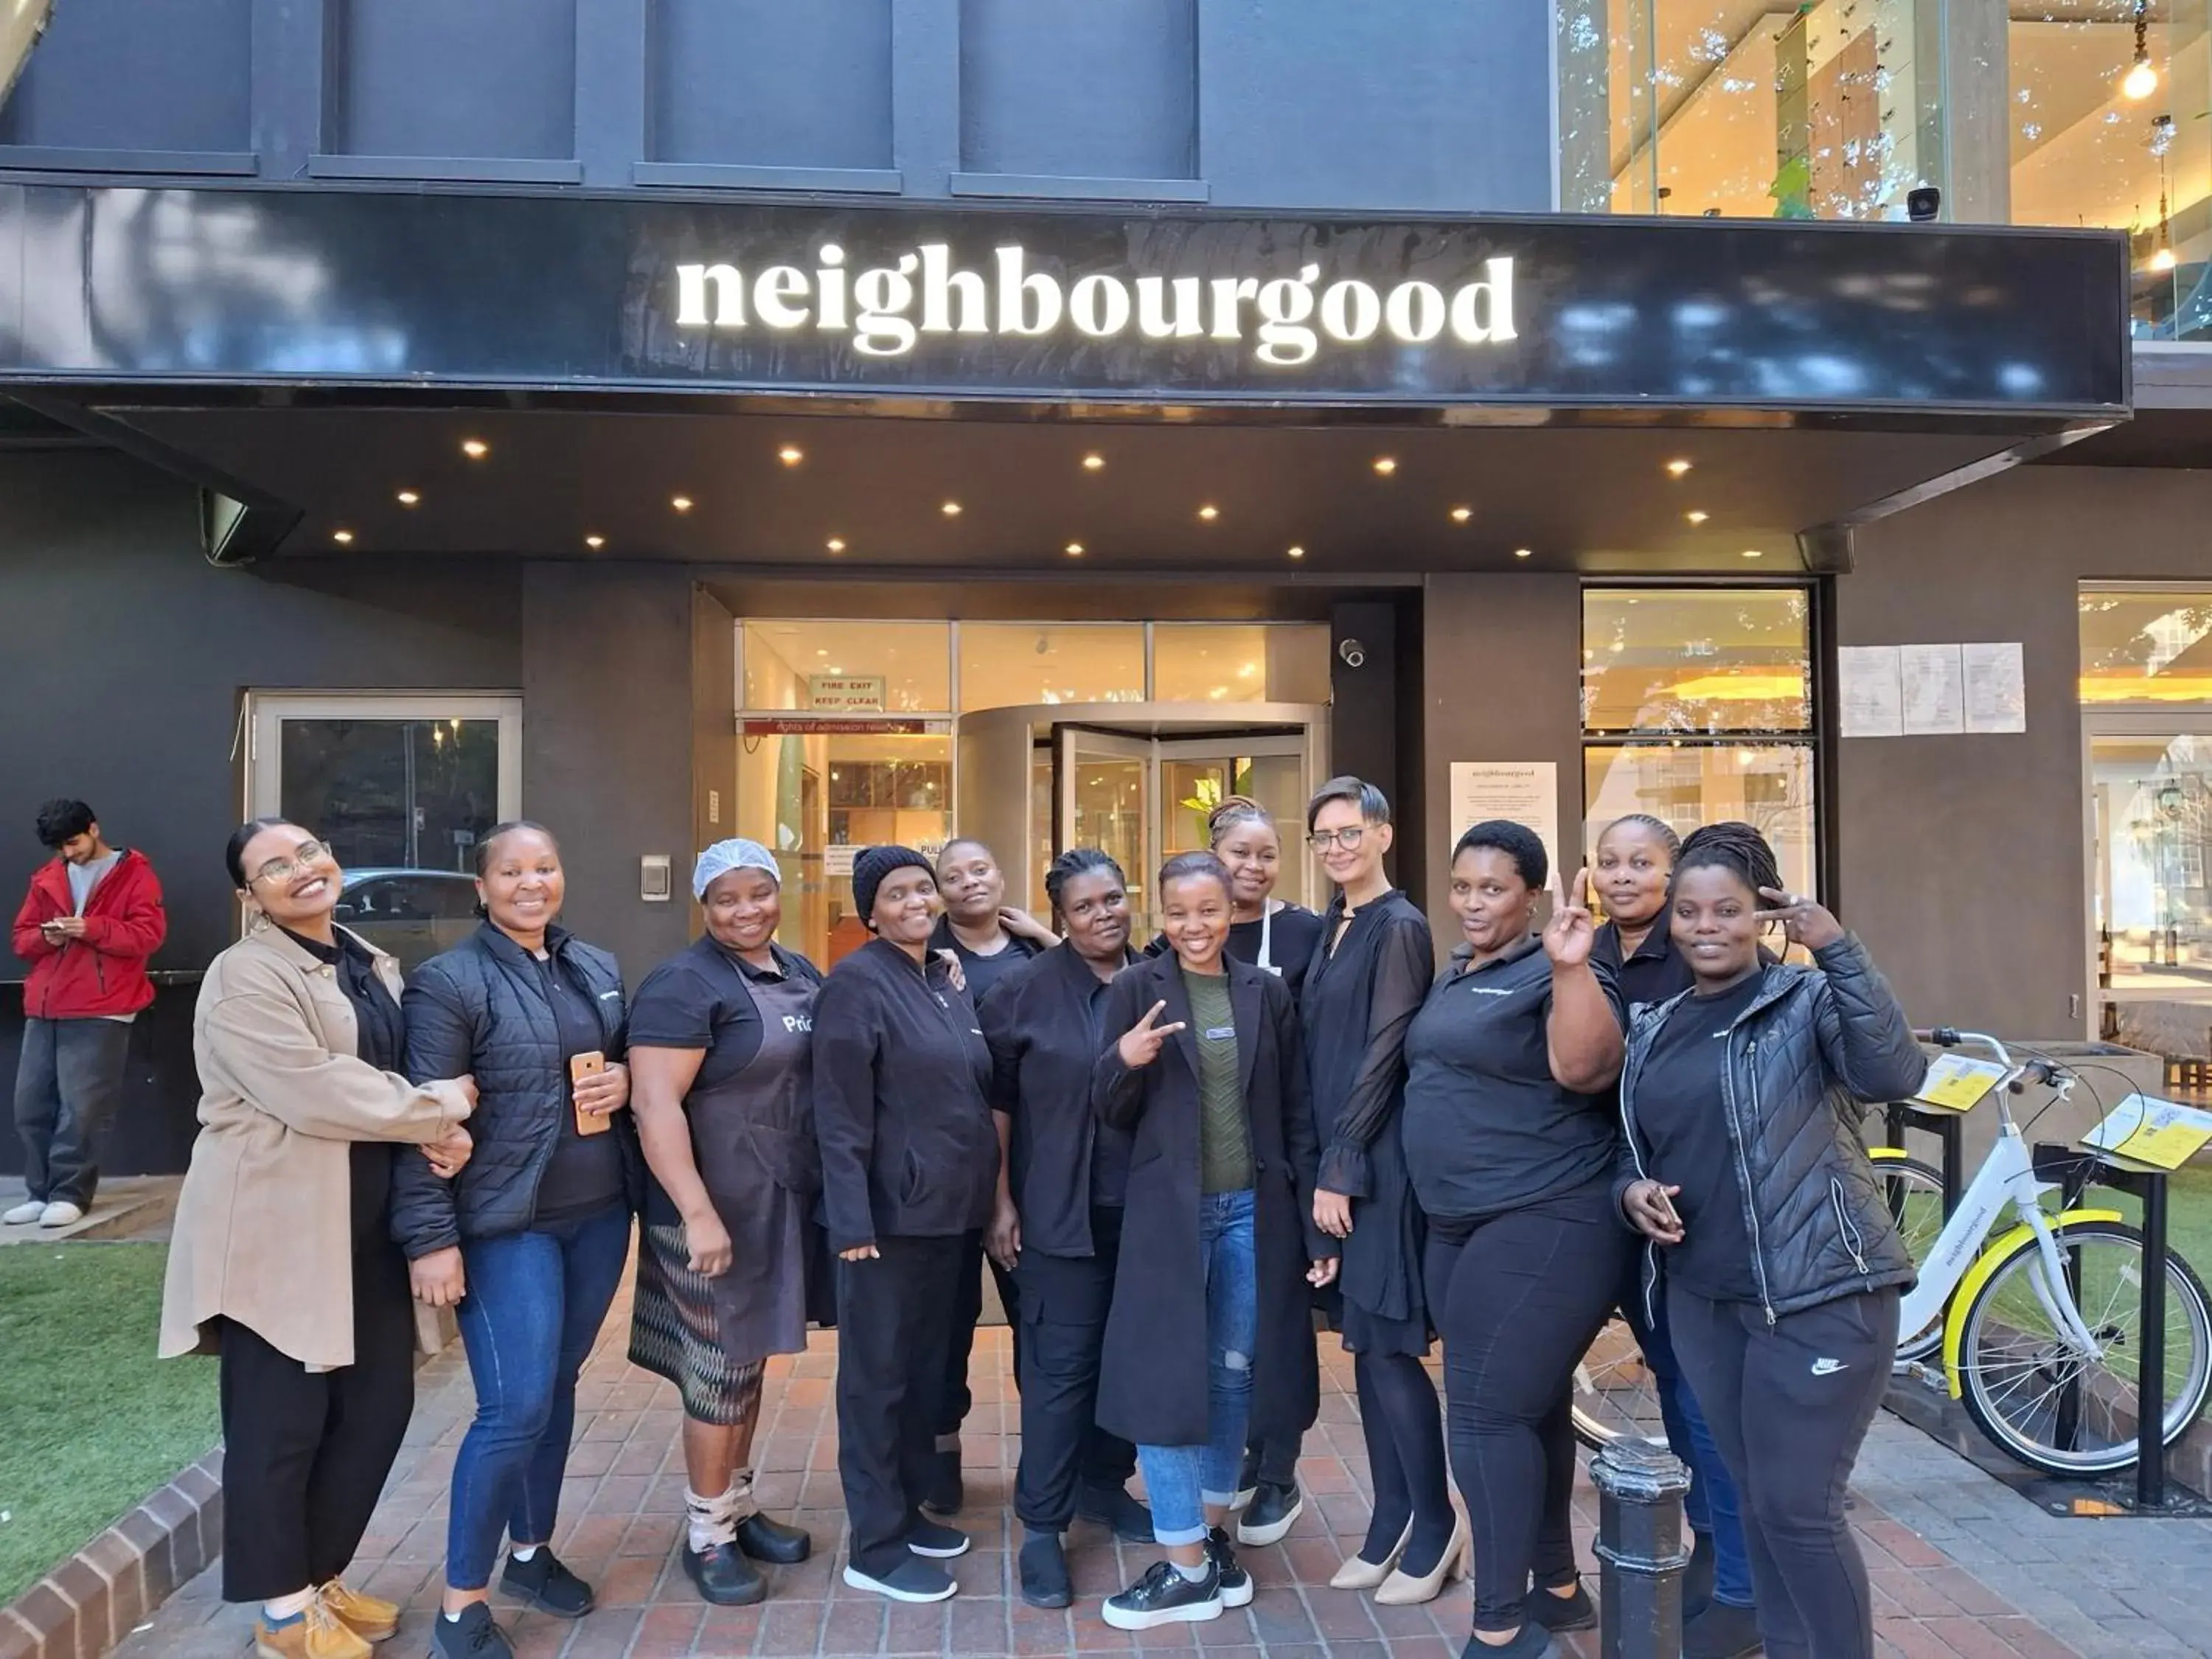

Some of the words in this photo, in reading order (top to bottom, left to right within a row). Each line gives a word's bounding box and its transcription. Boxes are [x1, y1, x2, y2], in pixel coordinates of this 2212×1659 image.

[675, 243, 1519, 365] neighbourgood
[821, 681, 844, 689] FIRE
[850, 681, 872, 689] EXIT
[815, 697, 841, 706] KEEP
[846, 697, 879, 706] CLEAR
